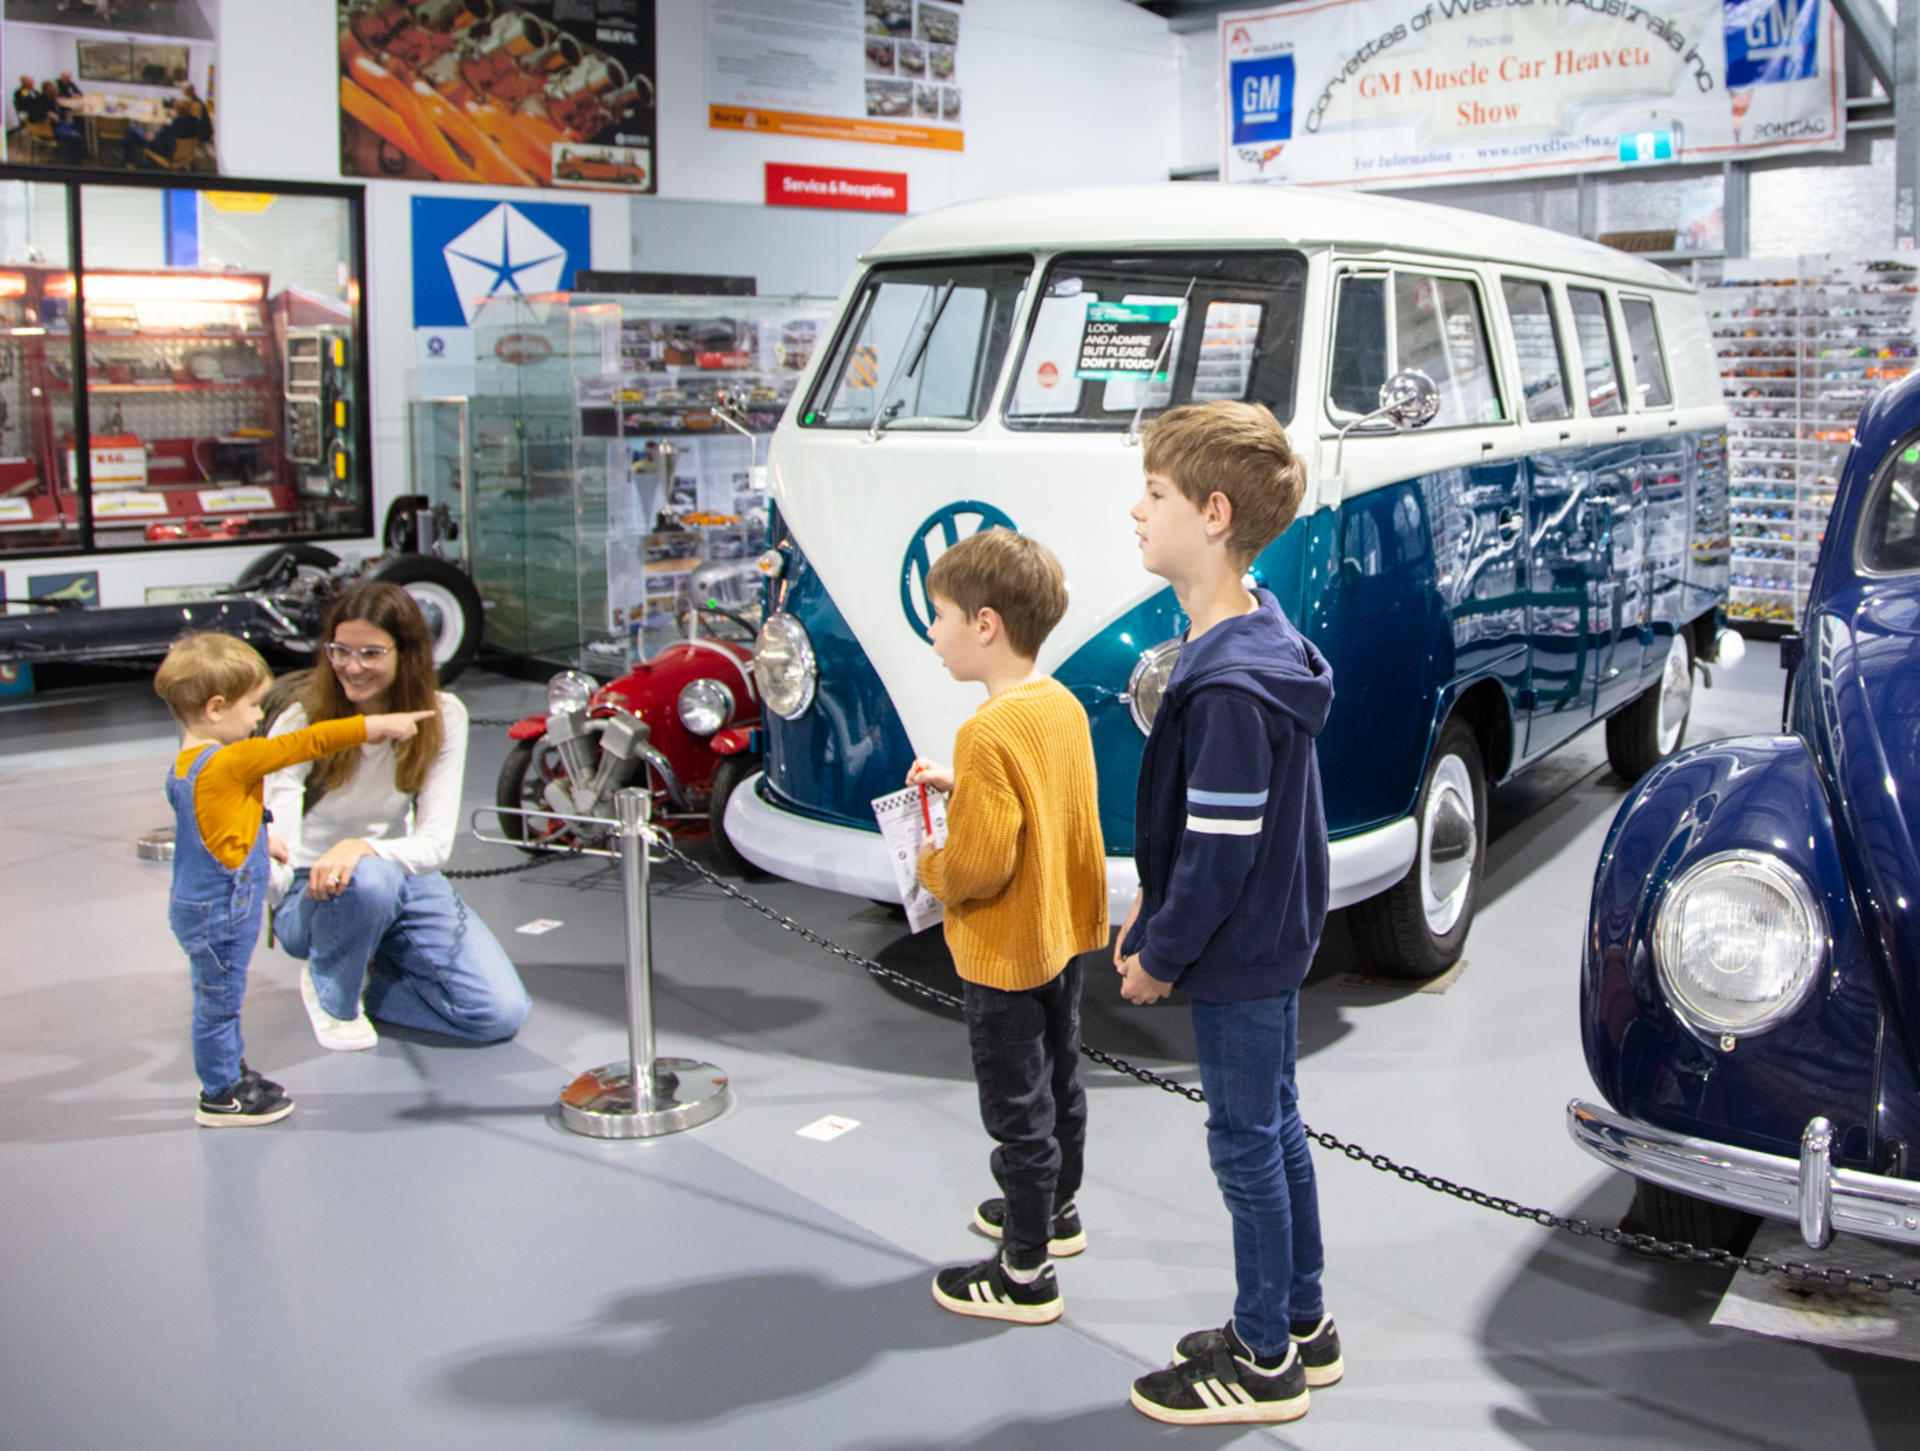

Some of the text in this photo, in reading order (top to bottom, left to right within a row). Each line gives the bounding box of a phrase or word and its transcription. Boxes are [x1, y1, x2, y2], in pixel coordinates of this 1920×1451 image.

[1745, 0, 1801, 47] GM
[1305, 24, 1407, 133] Corvettes
[1410, 3, 1433, 31] of
[1359, 46, 1650, 98] GM Muscle Car Heaven
[1241, 74, 1281, 113] GM
[1456, 100, 1520, 127] Show
[1753, 117, 1826, 141] PONTIAC
[1354, 155, 1374, 170] For
[1378, 152, 1453, 168] Information
[783, 177, 896, 199] Service & Reception
[1084, 334, 1152, 346] AND ADMIRE
[1087, 323, 1118, 334] LOOK
[1080, 357, 1117, 369] DON'T
[1082, 345, 1147, 358] BUT PLEASE
